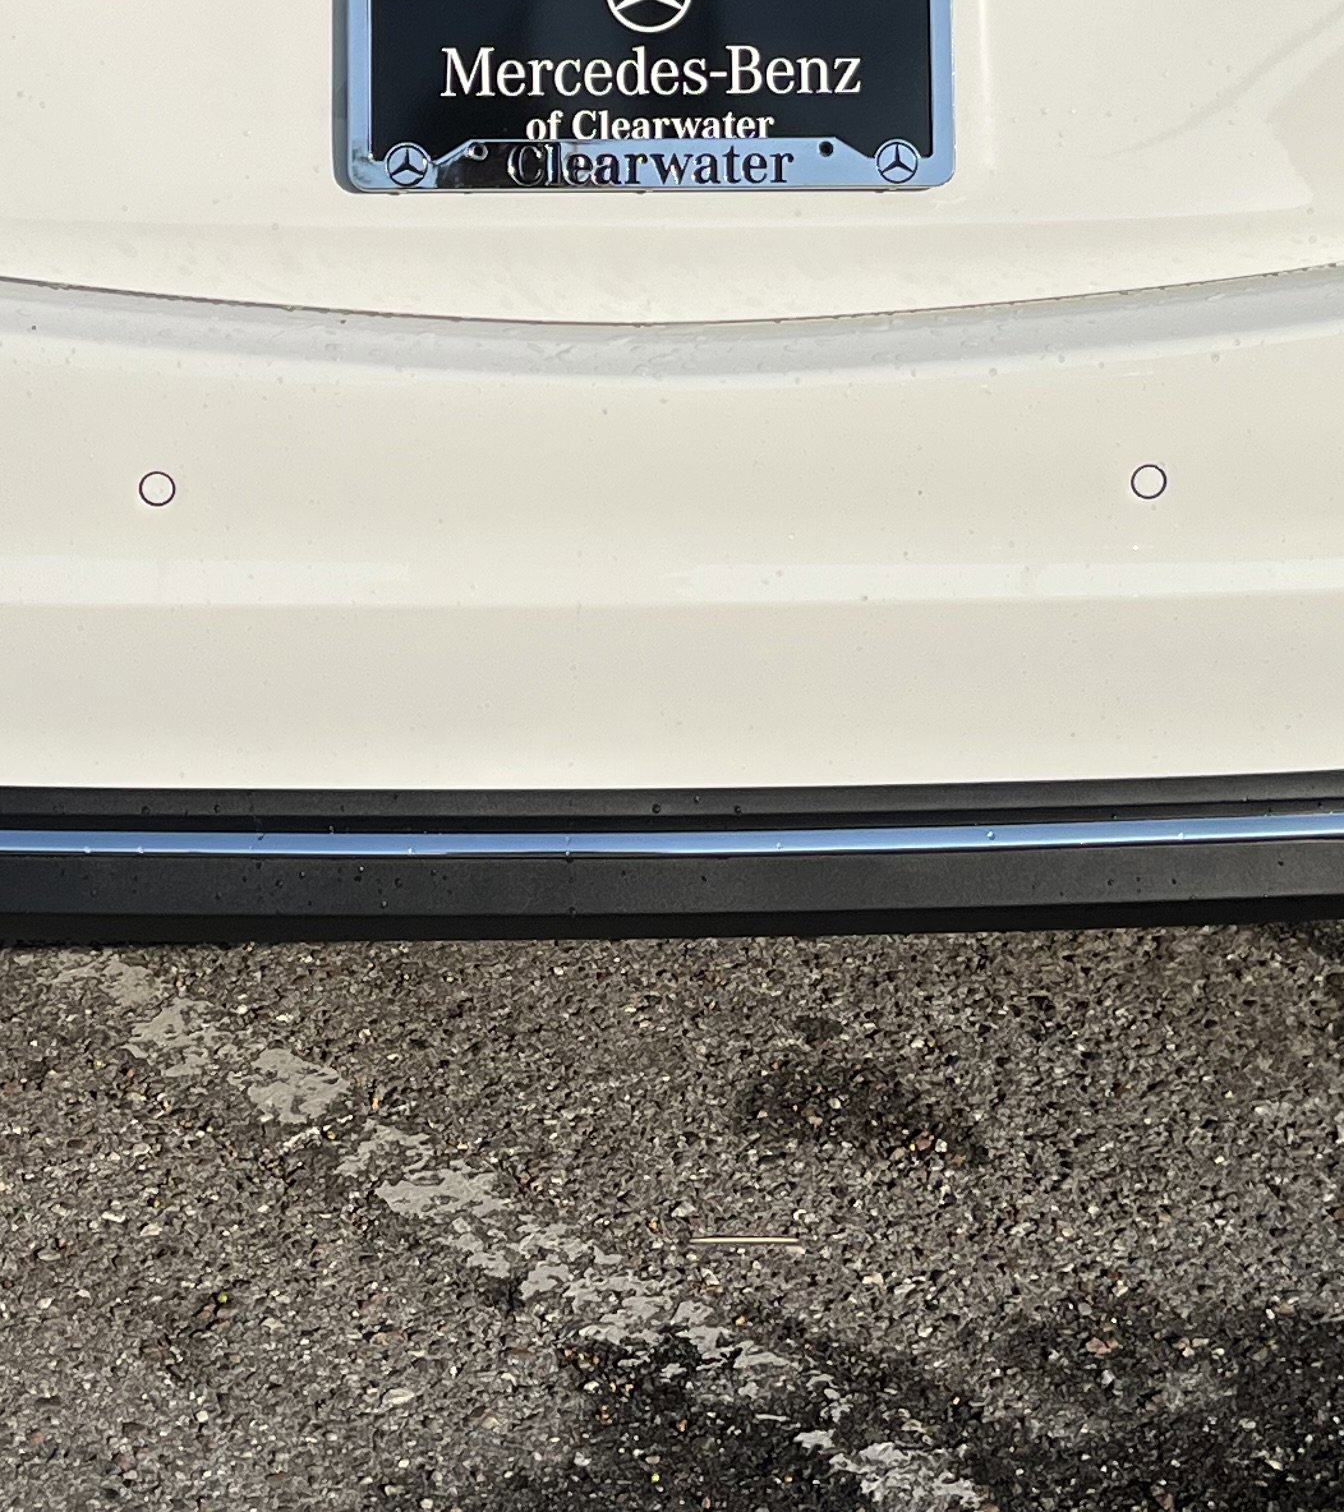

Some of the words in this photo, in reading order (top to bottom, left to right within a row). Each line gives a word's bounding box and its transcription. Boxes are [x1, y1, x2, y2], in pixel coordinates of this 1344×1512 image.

[439, 45, 863, 97] Mercedes-Benz
[526, 110, 564, 140] of
[571, 109, 775, 140] Clearwater
[506, 141, 795, 187] Clearwater
